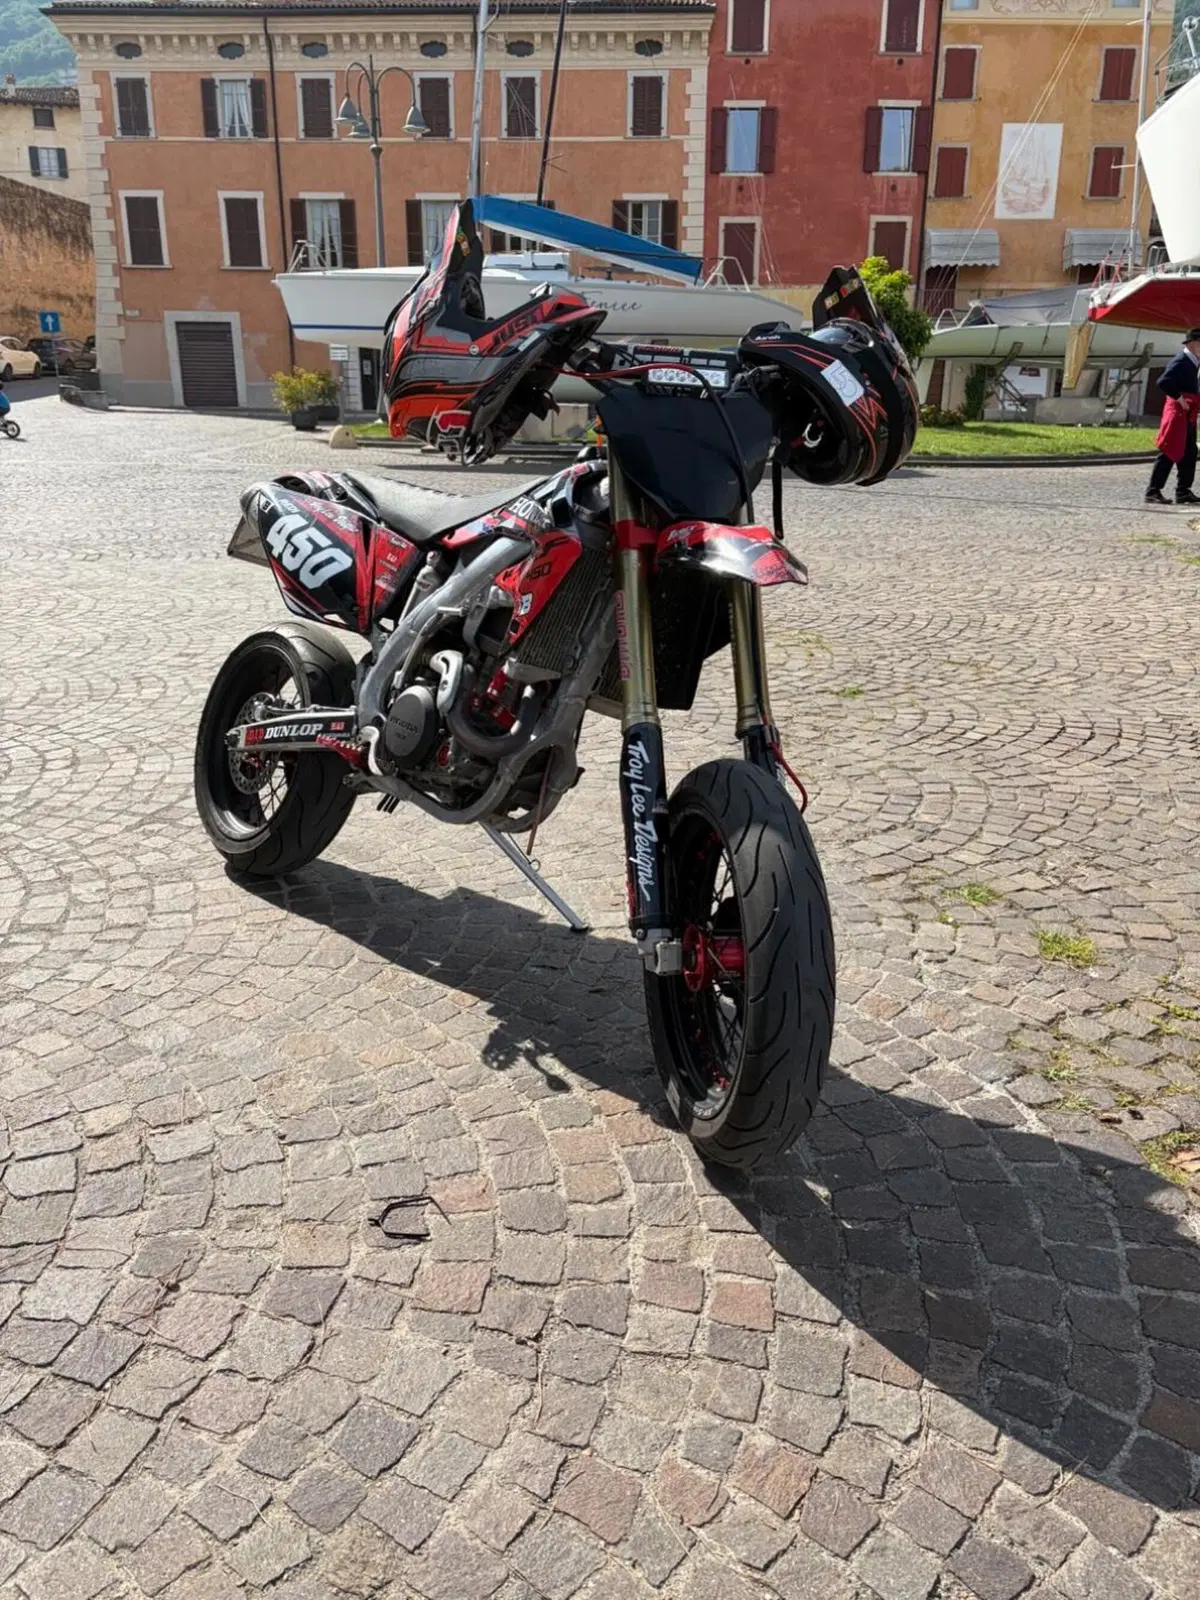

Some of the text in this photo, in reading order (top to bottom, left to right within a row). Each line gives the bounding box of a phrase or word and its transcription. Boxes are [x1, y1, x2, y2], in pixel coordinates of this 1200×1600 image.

[266, 514, 353, 589] 450
[264, 723, 324, 740] DUNLOP
[622, 740, 659, 902] Troy Lee Designs
